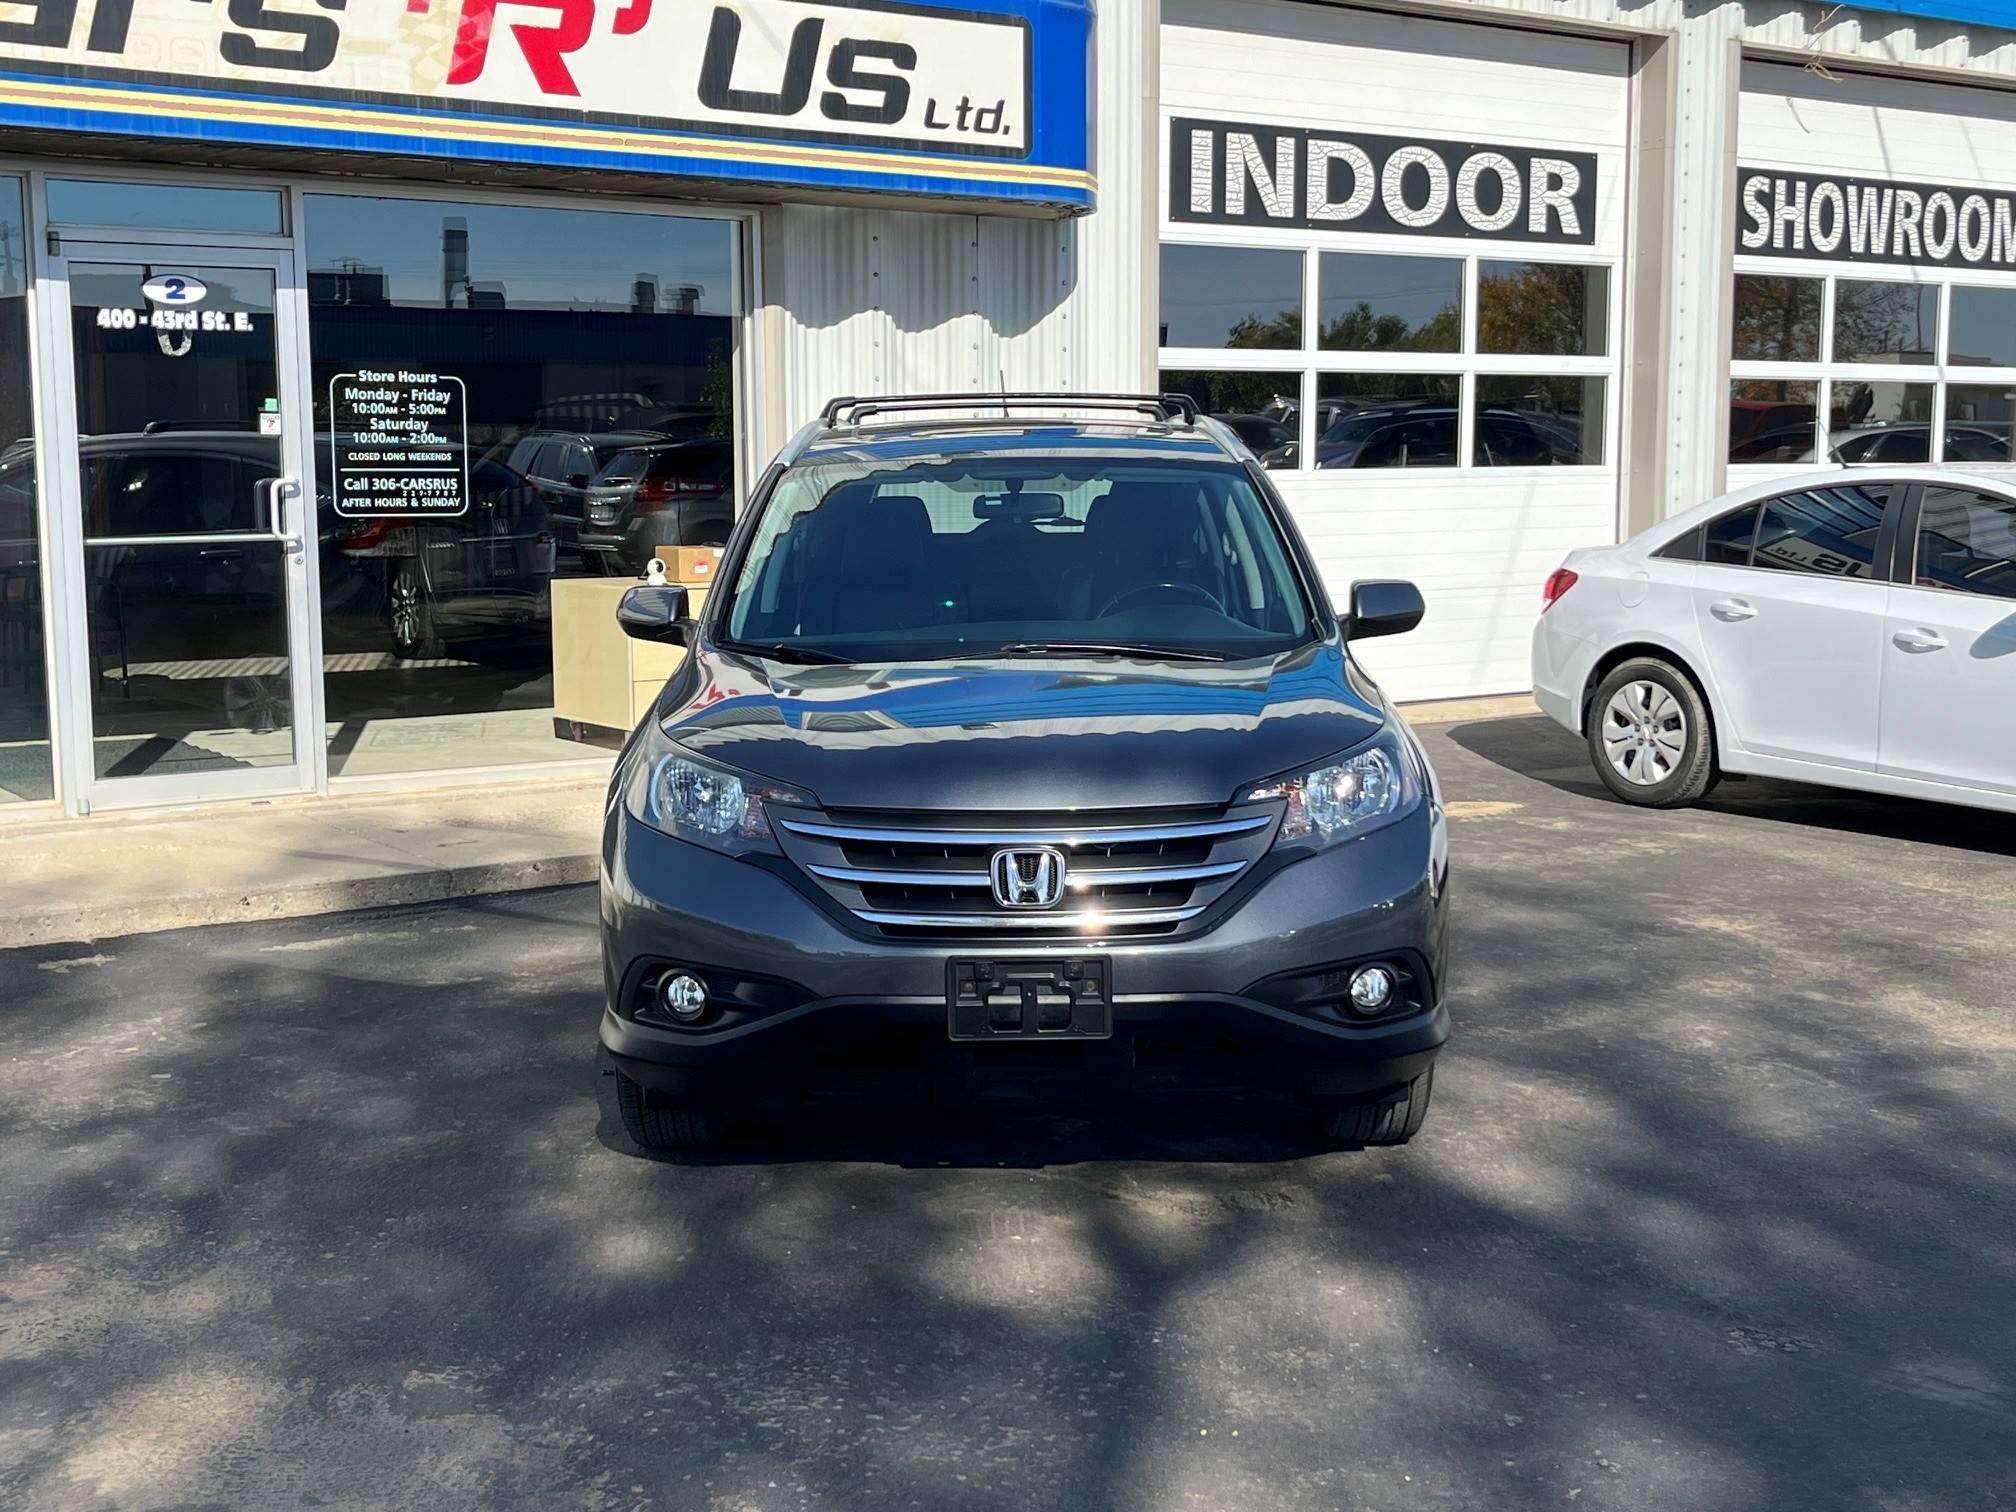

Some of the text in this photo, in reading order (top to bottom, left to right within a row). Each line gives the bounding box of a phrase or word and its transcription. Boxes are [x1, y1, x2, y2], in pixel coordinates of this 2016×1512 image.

[923, 96, 1010, 135] Ltd.
[1190, 129, 1582, 236] INDOOR
[164, 278, 186, 300] 2
[97, 308, 136, 329] 400
[151, 310, 198, 330] 43rd
[202, 311, 231, 331] St.
[234, 312, 254, 331] E.
[358, 370, 437, 383] Store Hours
[345, 388, 400, 403] Monday
[411, 389, 451, 404] Friday
[352, 403, 398, 414] 10:00AM
[408, 403, 446, 415] 5:00PM
[370, 418, 429, 432] Saturday
[352, 433, 399, 444] 10:00AM
[409, 433, 447, 444] 2:00PM
[348, 453, 452, 461] CLOSED LONG WEEKENDS
[344, 477, 458, 490] Call 306-CARSRUS
[342, 497, 460, 507] AFTER HOURS & SUNDAY
